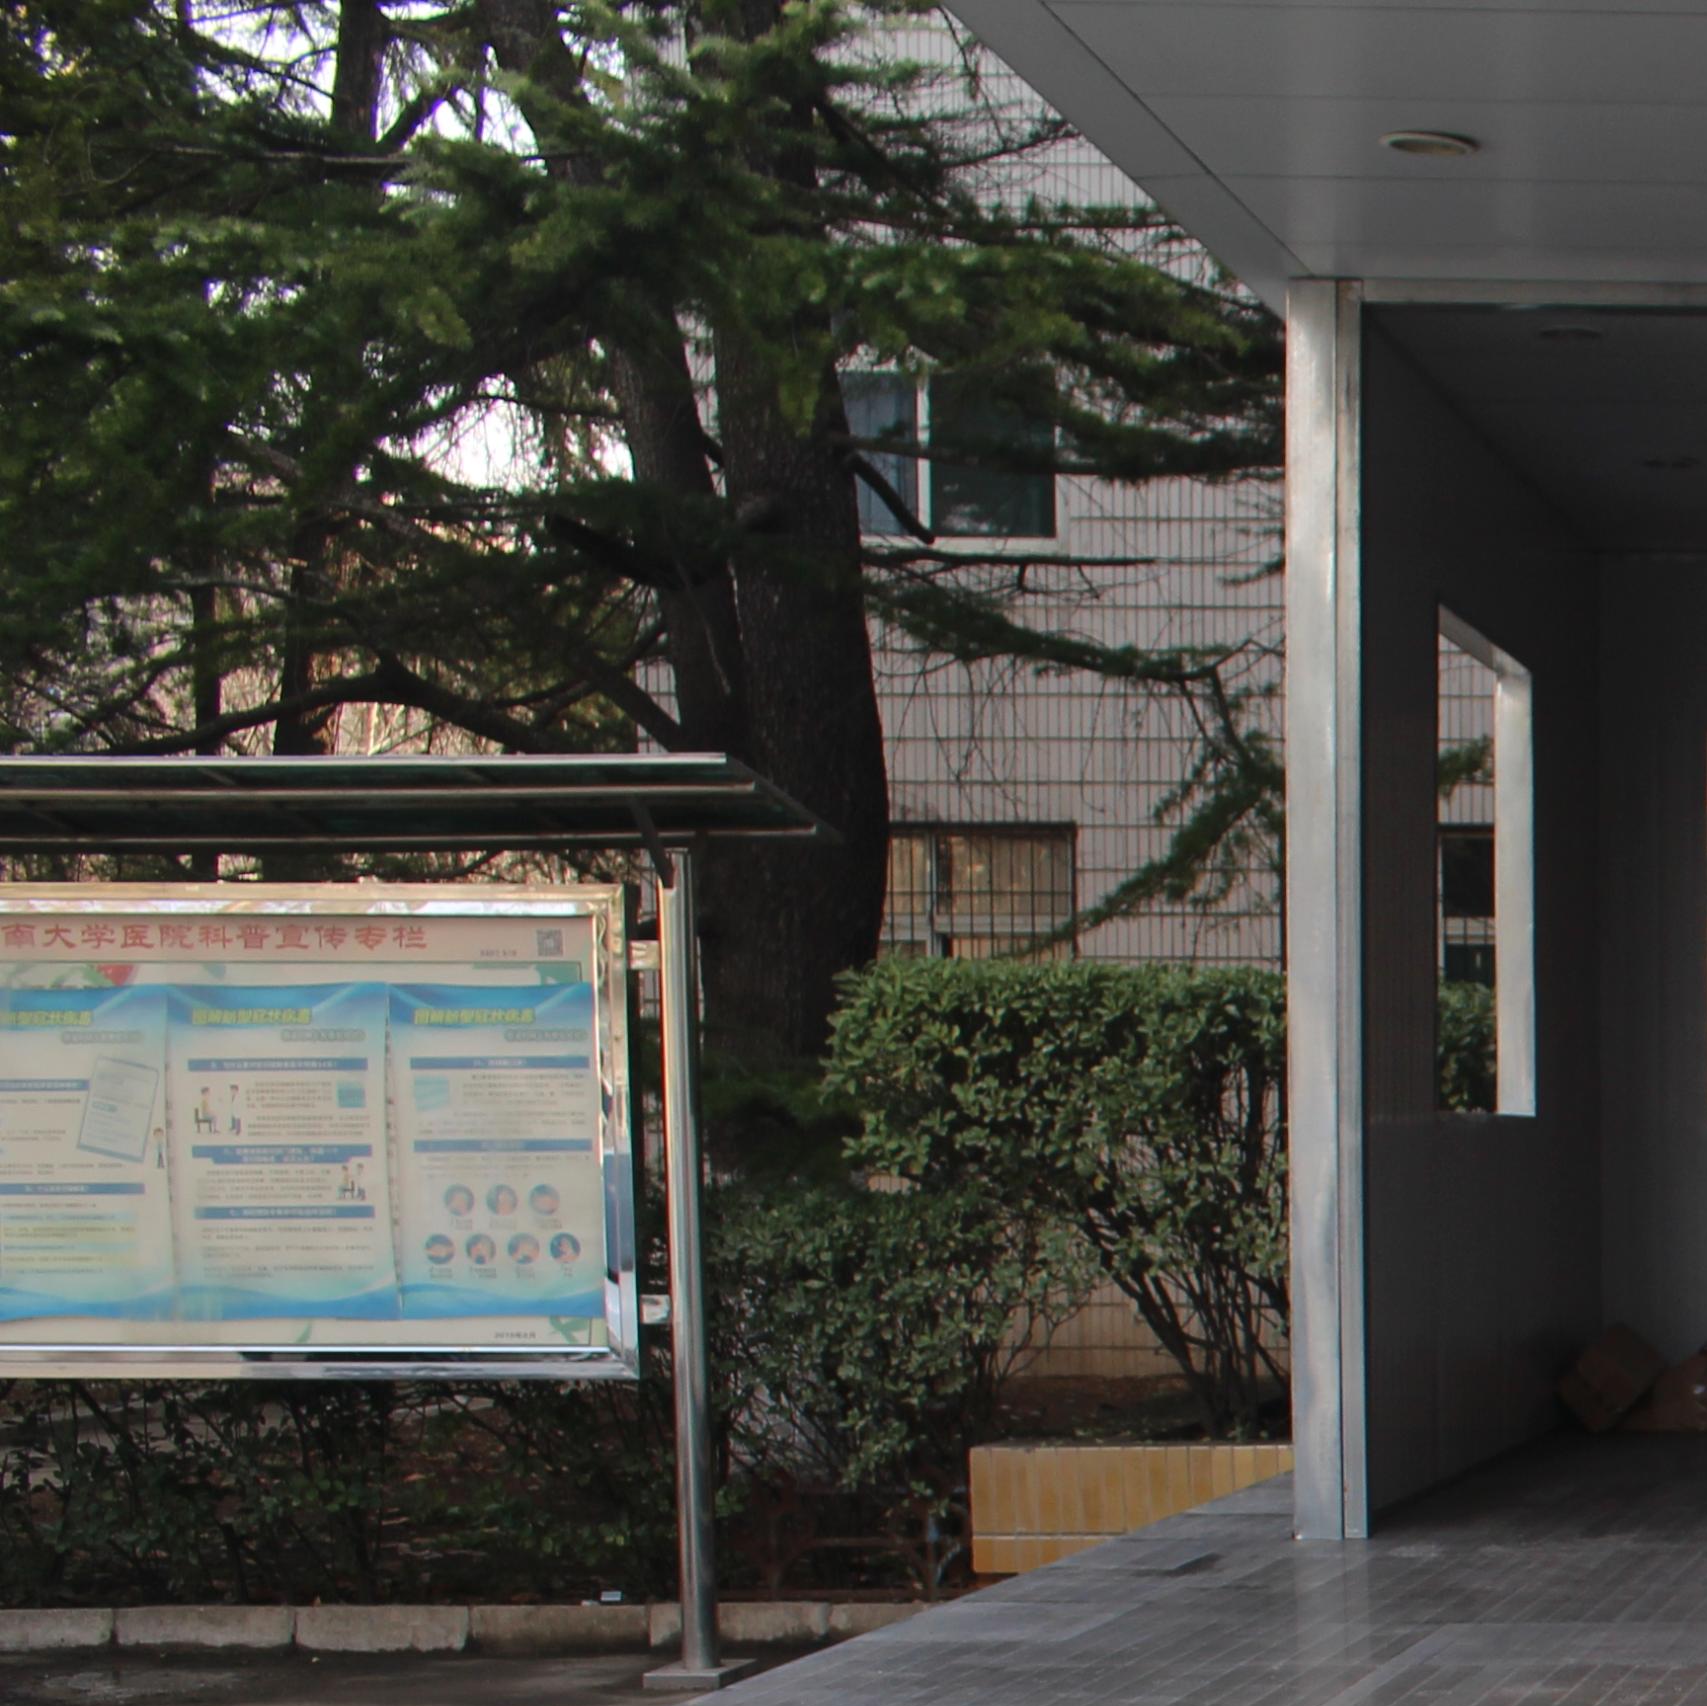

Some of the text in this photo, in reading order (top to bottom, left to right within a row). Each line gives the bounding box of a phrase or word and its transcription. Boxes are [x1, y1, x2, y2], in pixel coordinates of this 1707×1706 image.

[1, 923, 428, 950] 南大学医院科普宣传专栏
